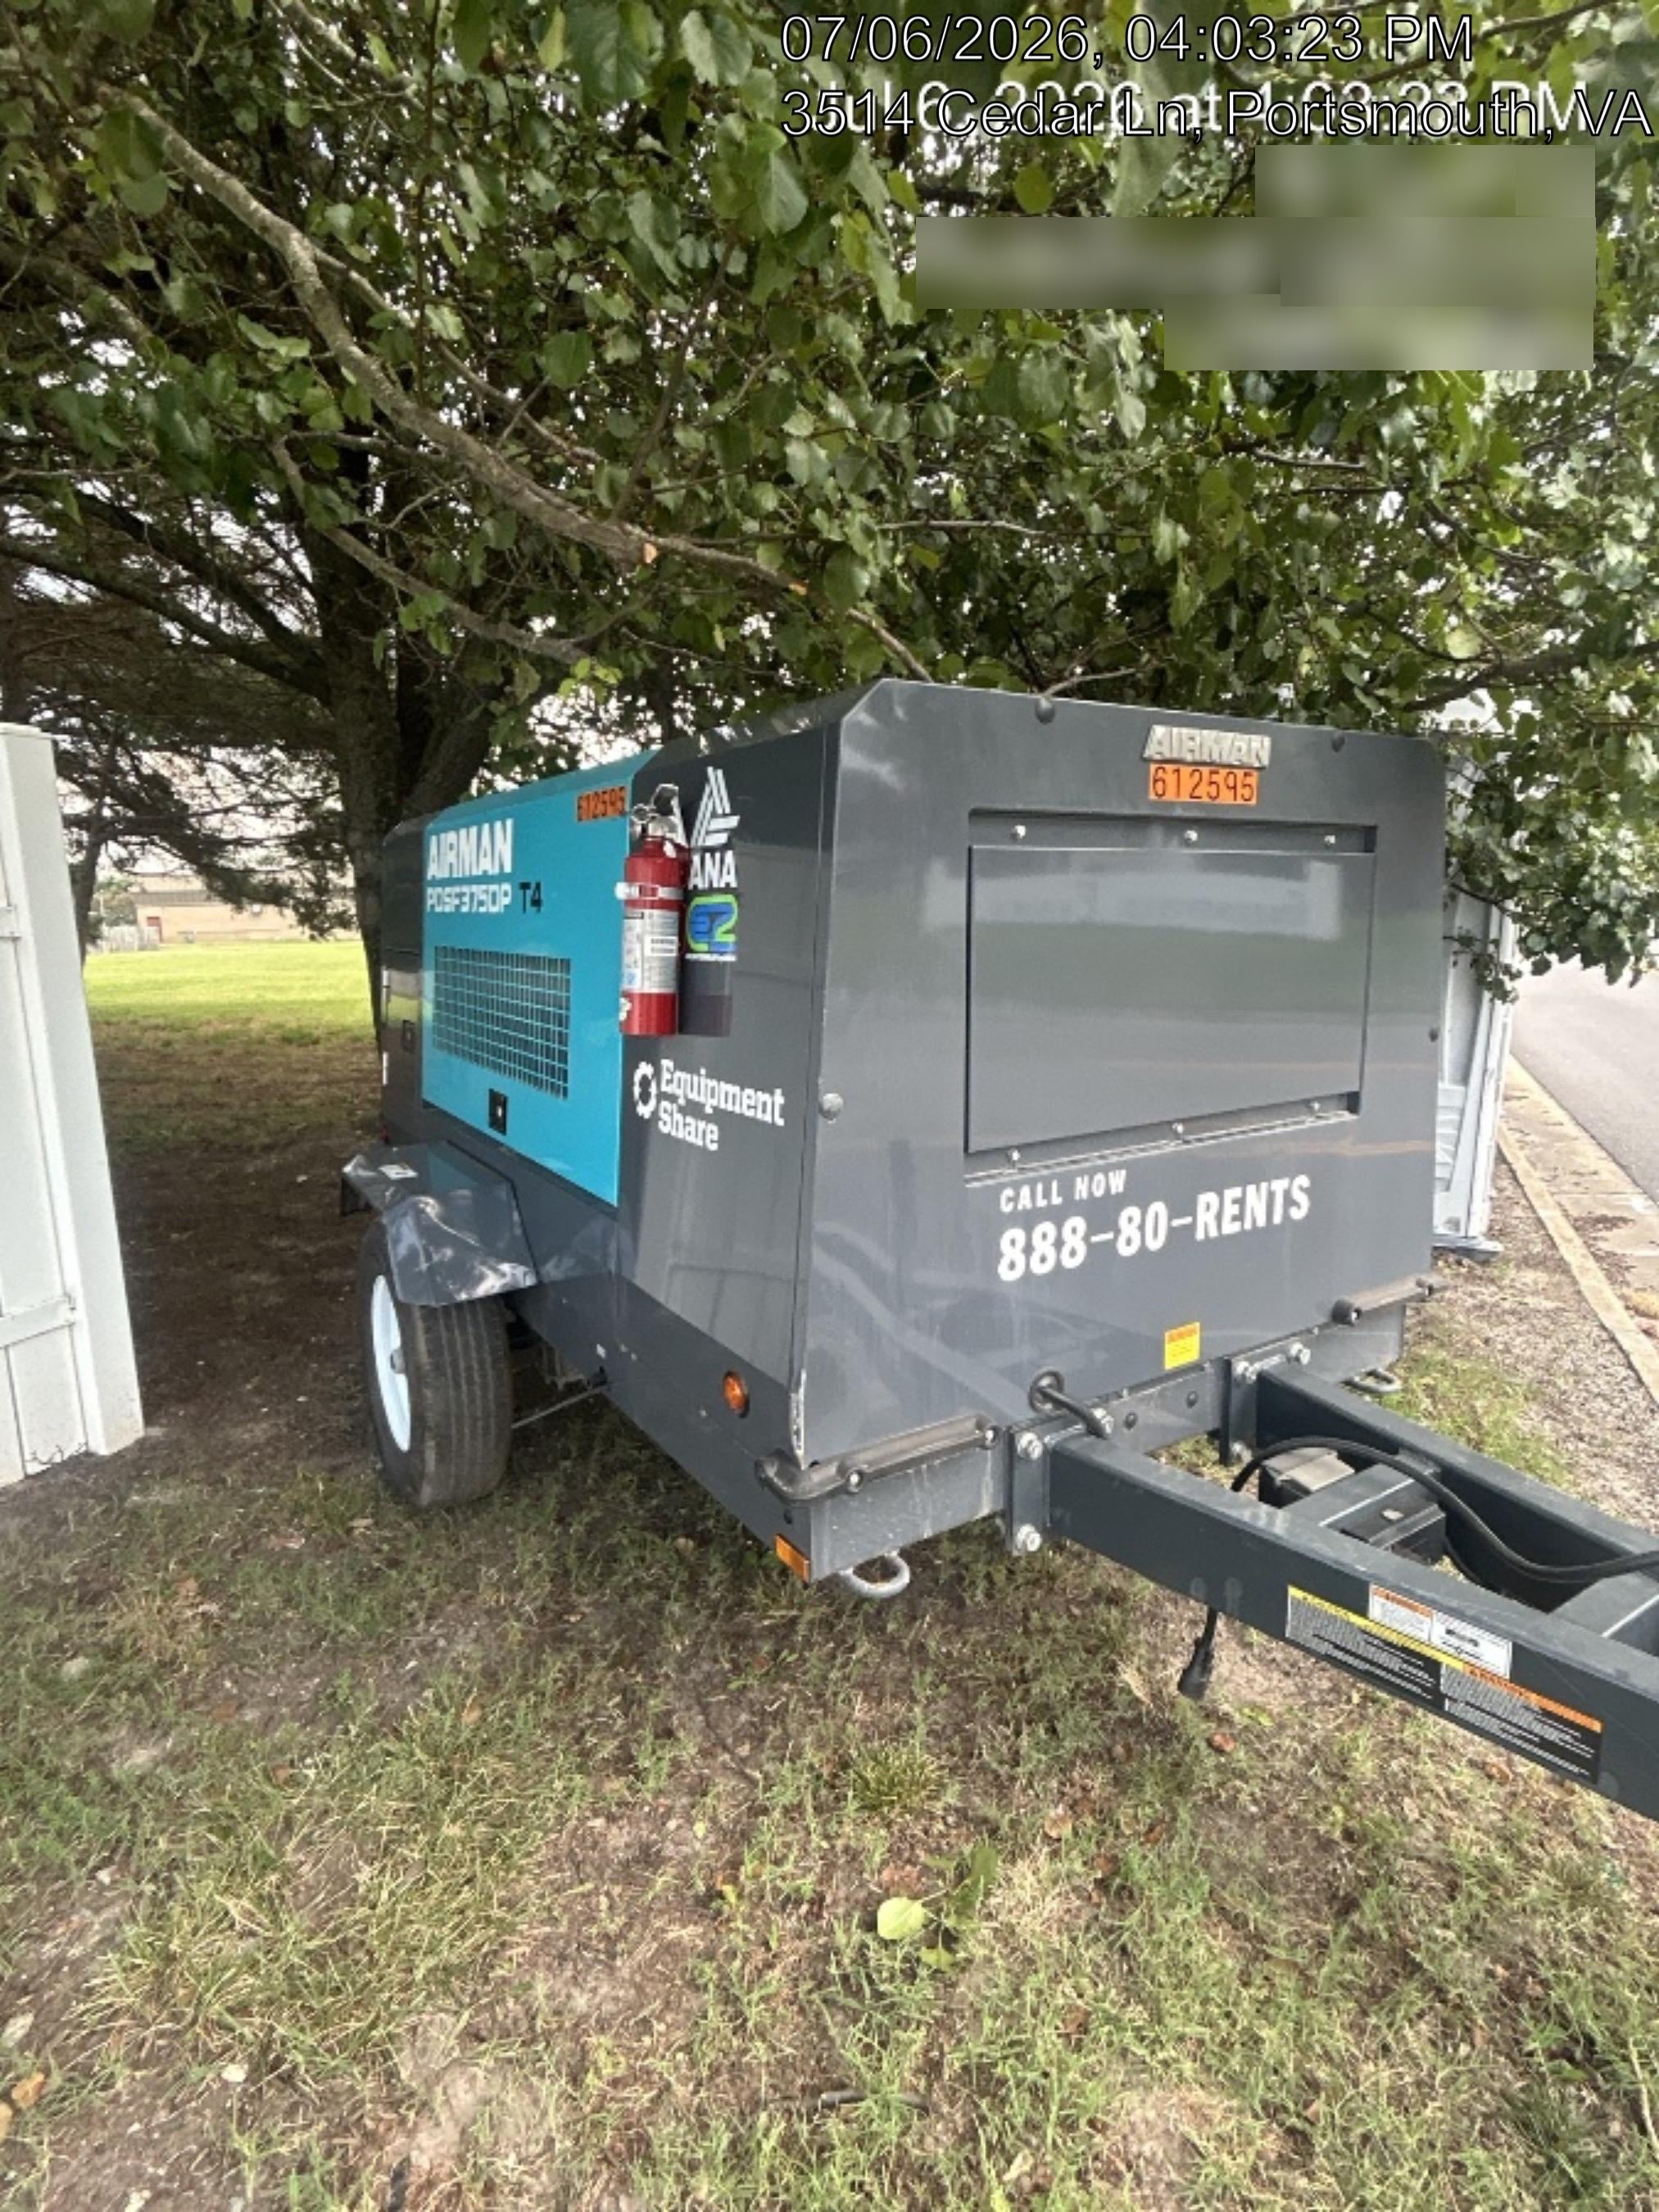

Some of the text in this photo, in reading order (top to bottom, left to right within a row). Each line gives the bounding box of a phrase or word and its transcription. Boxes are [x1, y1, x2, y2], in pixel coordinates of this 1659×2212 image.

[1143, 724, 1271, 768] AIRMAN
[1152, 766, 1255, 802] 612595
[427, 818, 514, 881] AIRMAN
[688, 849, 738, 891] ANA
[519, 880, 544, 913] T4
[660, 1058, 785, 1126] Equipment
[658, 1099, 719, 1151] Share
[999, 1168, 1127, 1213] CALL NOW
[996, 1173, 1312, 1282] 888-80-RENTS
